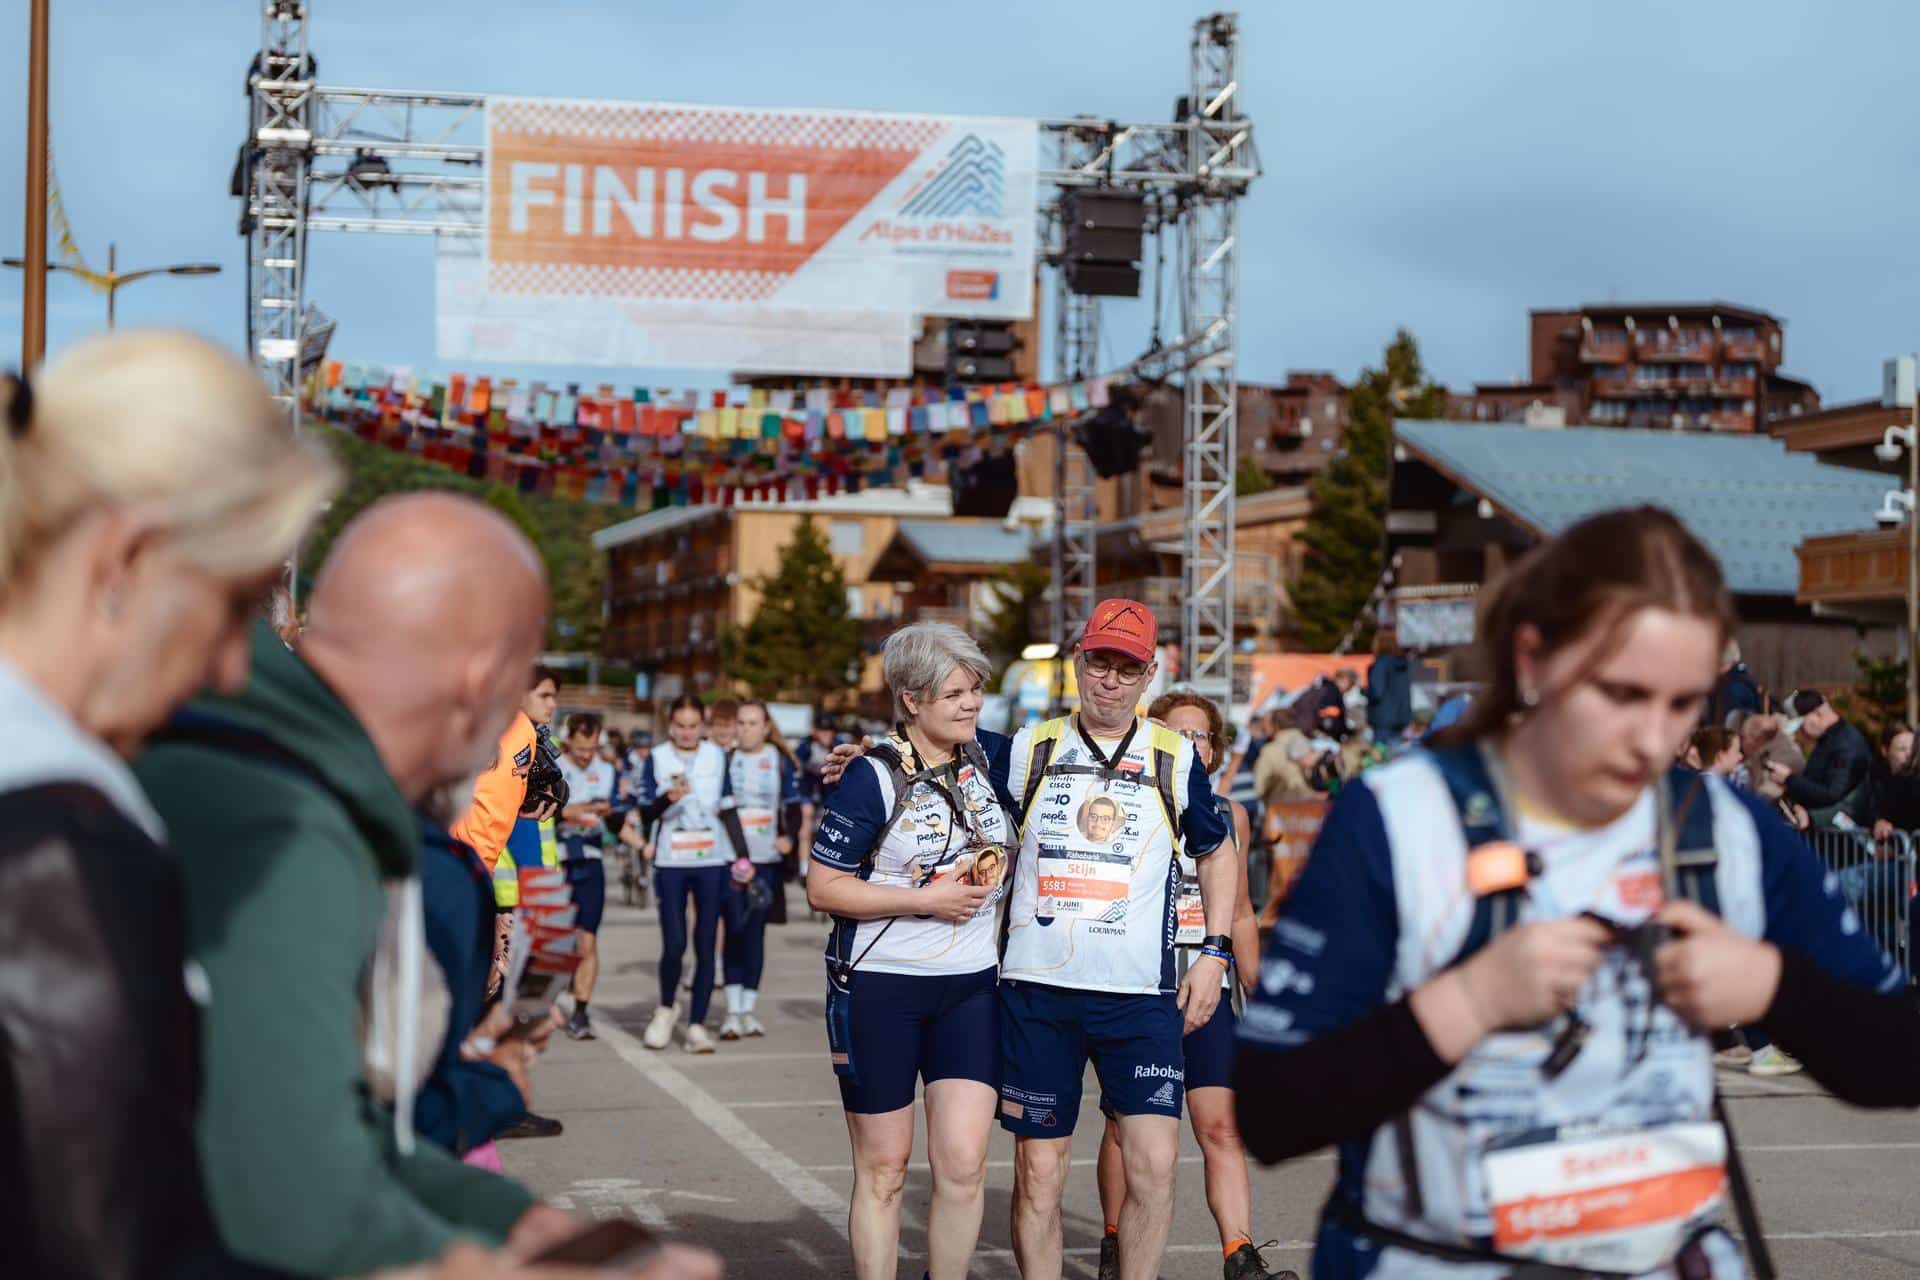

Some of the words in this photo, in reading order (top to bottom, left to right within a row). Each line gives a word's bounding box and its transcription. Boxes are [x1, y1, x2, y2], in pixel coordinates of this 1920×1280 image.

[508, 160, 809, 246] FINISH
[858, 219, 921, 245] Alpe
[1067, 863, 1097, 877] Stijn
[1042, 880, 1066, 891] 5583
[1088, 926, 1126, 936] LOUWMAN
[1134, 1063, 1185, 1082] Raboban
